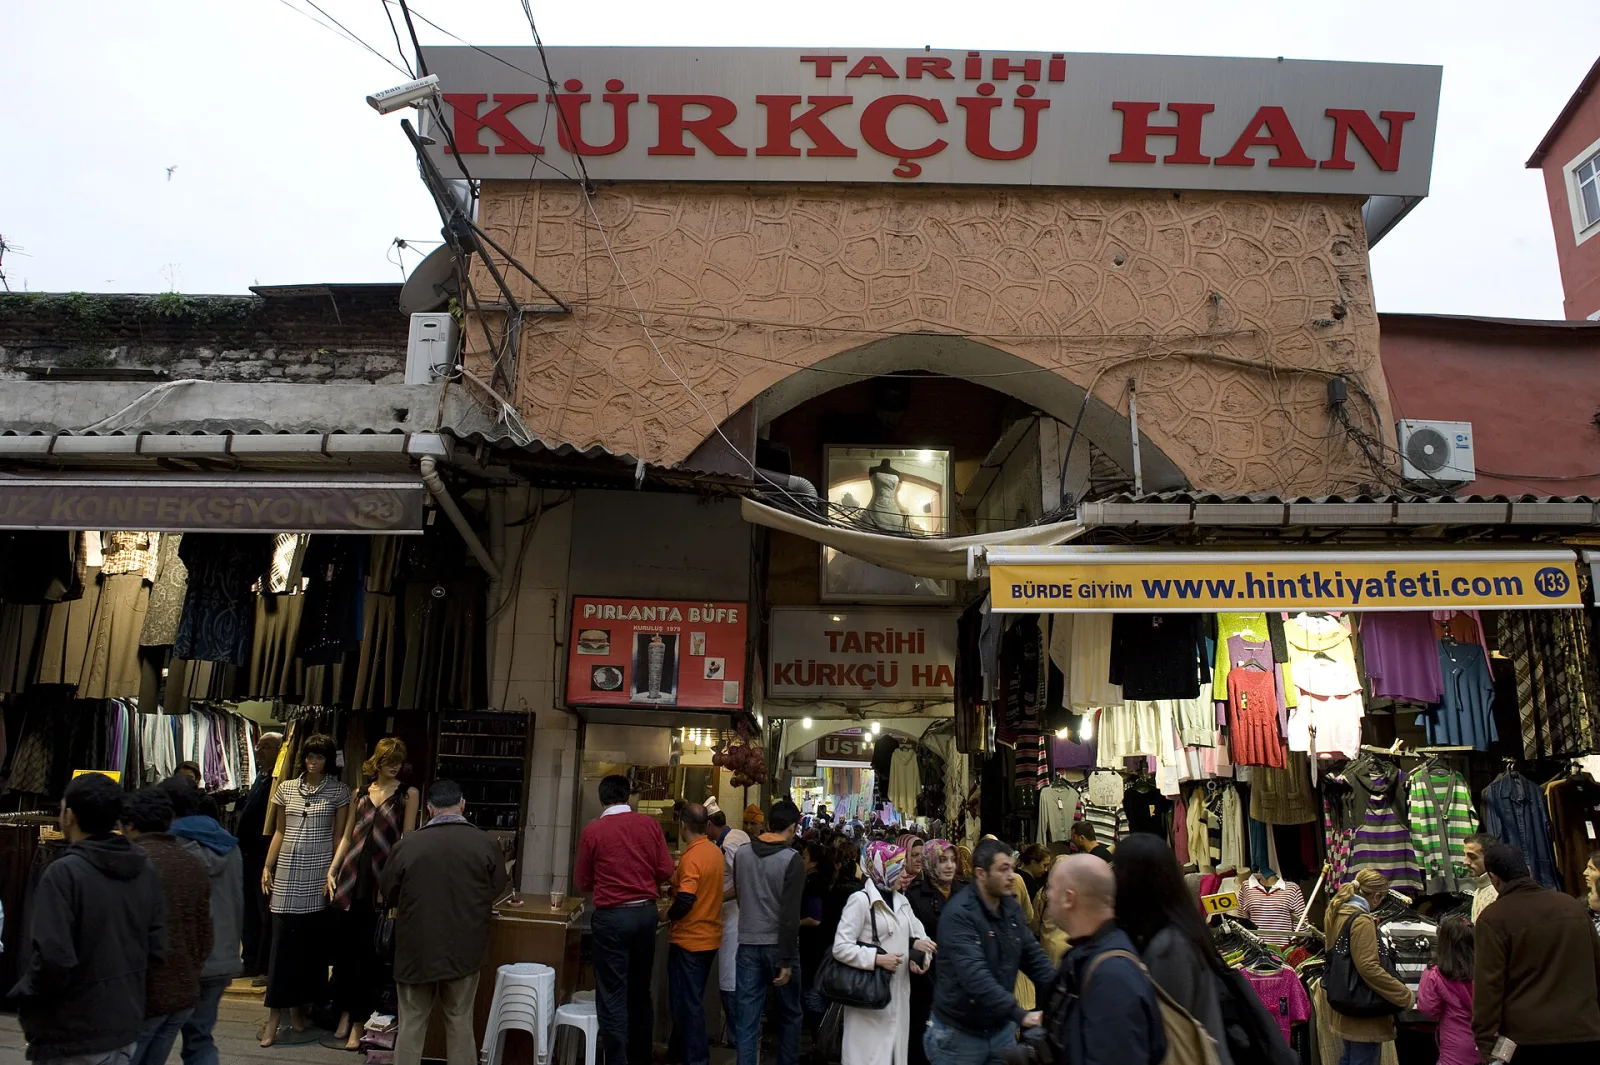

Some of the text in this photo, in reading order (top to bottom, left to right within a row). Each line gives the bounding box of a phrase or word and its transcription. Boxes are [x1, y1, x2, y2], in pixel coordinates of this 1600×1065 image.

[800, 51, 1066, 82] TARİHİ
[443, 79, 1416, 177] KÜRKÇÜ HAN
[1012, 570, 1566, 604] BÜRDE GİYİM www.hintkiyafeti.com 133
[584, 604, 738, 624] PIRLANTA BÜFE
[824, 628, 925, 654] TARİHİ
[774, 660, 898, 690] KÜRKÇÜ
[1210, 897, 1232, 910] 10
